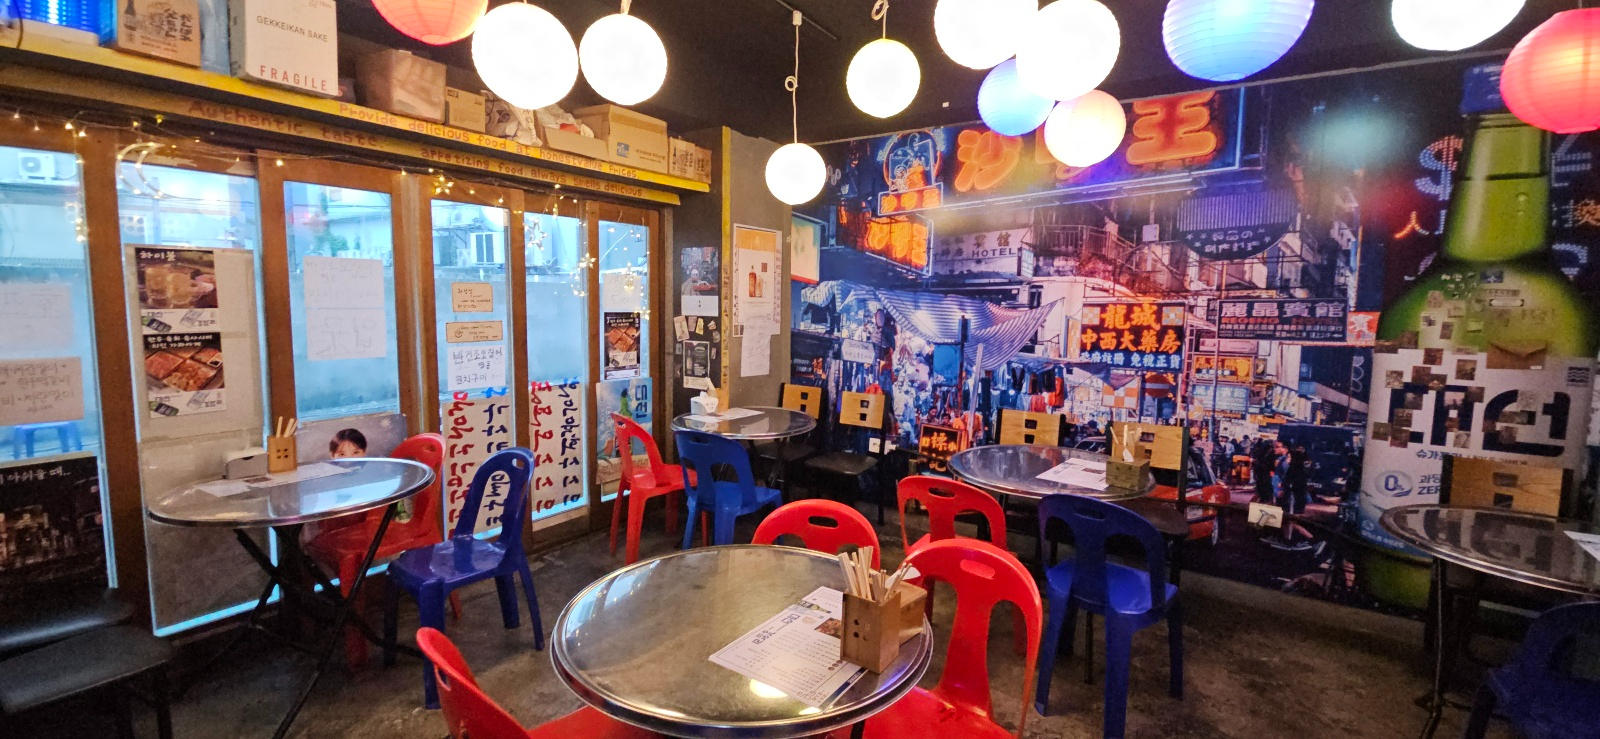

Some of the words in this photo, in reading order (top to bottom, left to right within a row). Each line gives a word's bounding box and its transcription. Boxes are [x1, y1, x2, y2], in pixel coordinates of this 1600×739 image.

[256, 15, 305, 36] GEKKEIKAN
[307, 30, 329, 42] SAKE
[260, 65, 327, 91] FRAGILE
[339, 101, 398, 127] Provide
[408, 120, 470, 142] delicious
[476, 134, 507, 150] food
[516, 143, 531, 156] at
[955, 90, 1217, 192] 沙王
[187, 101, 303, 135] Authentic
[320, 125, 384, 149] taste.
[531, 168, 567, 184] always
[573, 177, 601, 190] smells
[604, 182, 646, 197] delicious.
[139, 250, 176, 262] 하이볼
[971, 247, 1017, 258] HOTEL
[1100, 303, 1161, 331] 龍城
[1220, 302, 1345, 318] 麗晶賓館
[1081, 328, 1181, 354] 中西大藥房
[1079, 350, 1126, 366] 政府註冊
[1384, 474, 1404, 492] 0%
[1417, 485, 1441, 496] ZER
